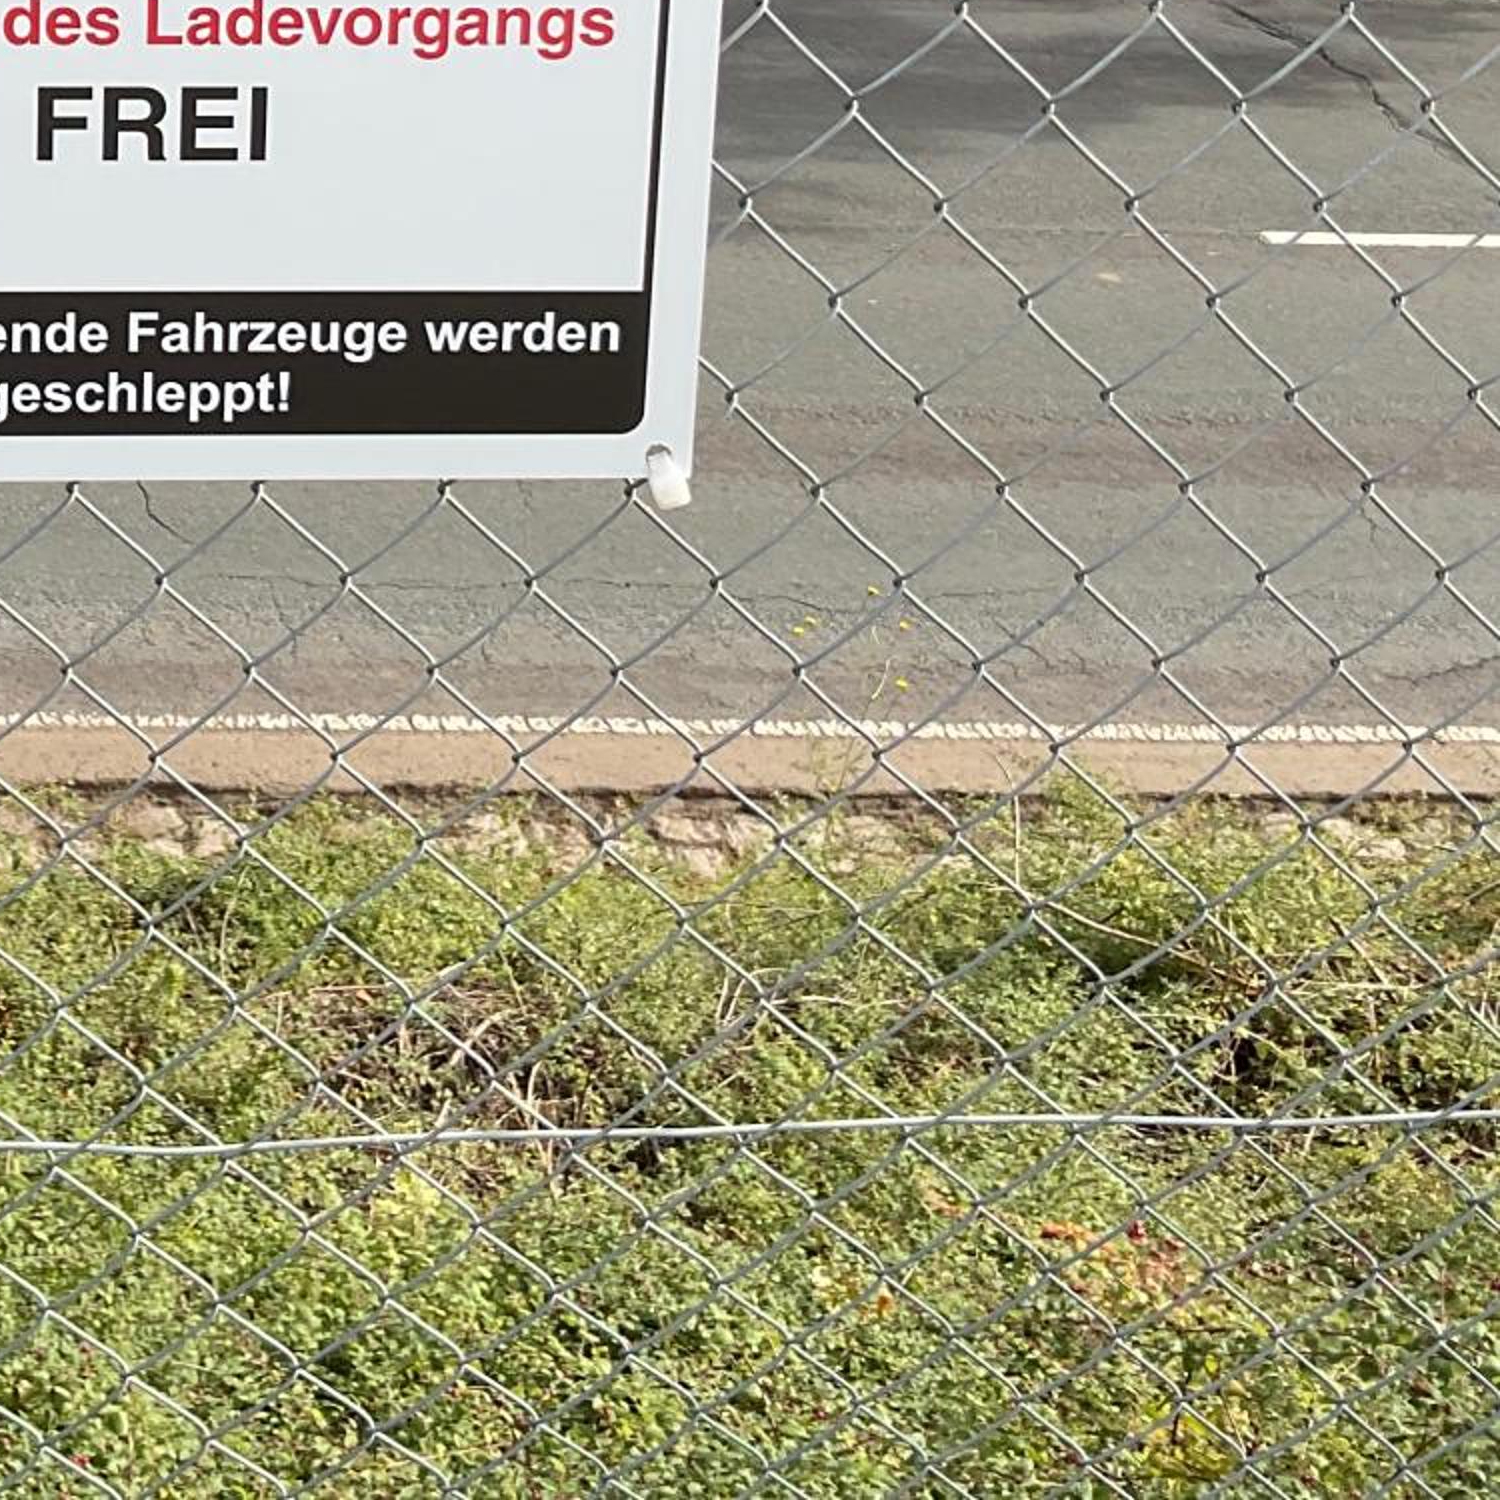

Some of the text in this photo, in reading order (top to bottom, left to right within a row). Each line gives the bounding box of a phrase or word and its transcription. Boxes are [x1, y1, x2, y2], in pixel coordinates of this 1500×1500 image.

[37, 87, 268, 161] FREI
[129, 312, 406, 362] Fahrzeuge
[425, 312, 619, 352] werden
